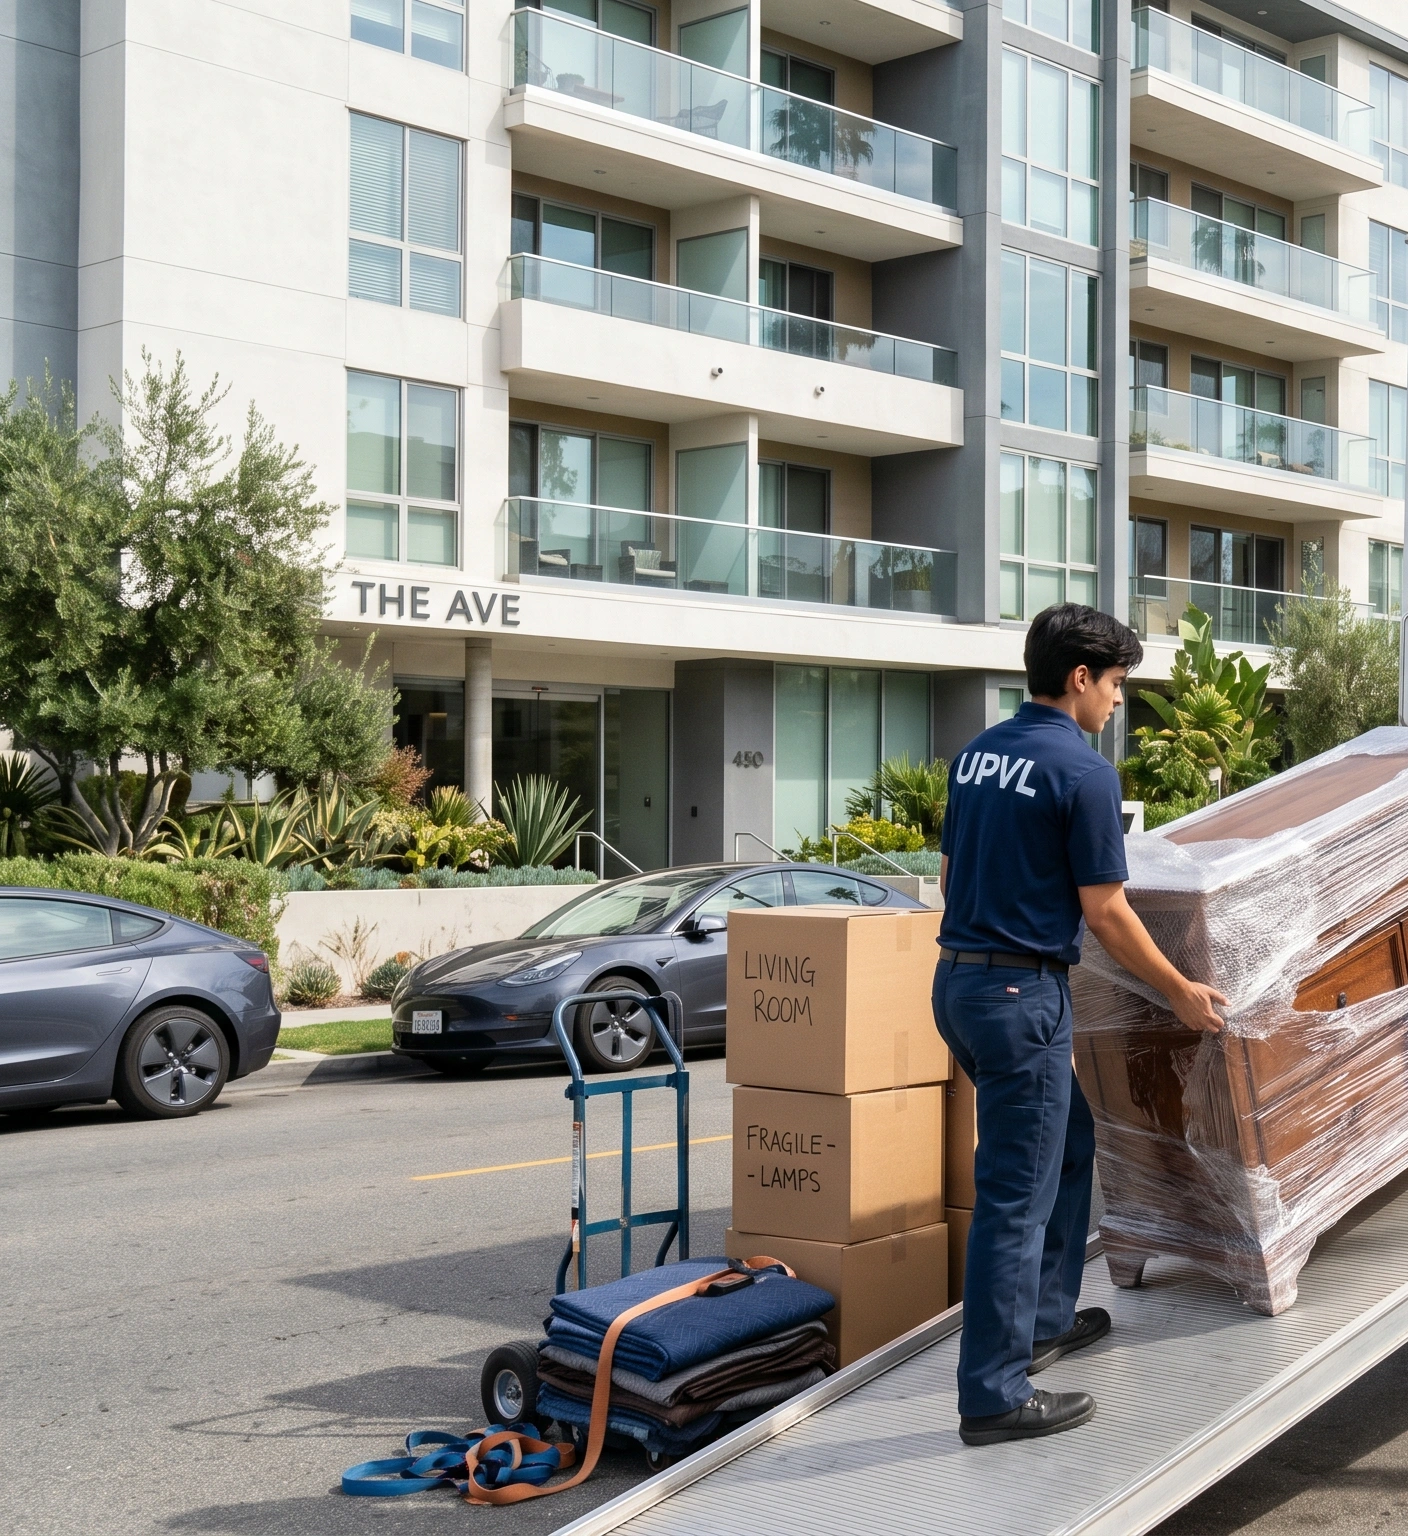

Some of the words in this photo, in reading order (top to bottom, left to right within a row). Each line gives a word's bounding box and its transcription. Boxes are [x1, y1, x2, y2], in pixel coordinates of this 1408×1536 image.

[352, 581, 431, 620] THE
[445, 590, 521, 626] AVE
[732, 750, 765, 769] 450
[956, 751, 1037, 798] UPVL
[744, 950, 816, 988] LIVING
[753, 989, 813, 1027] ROOM
